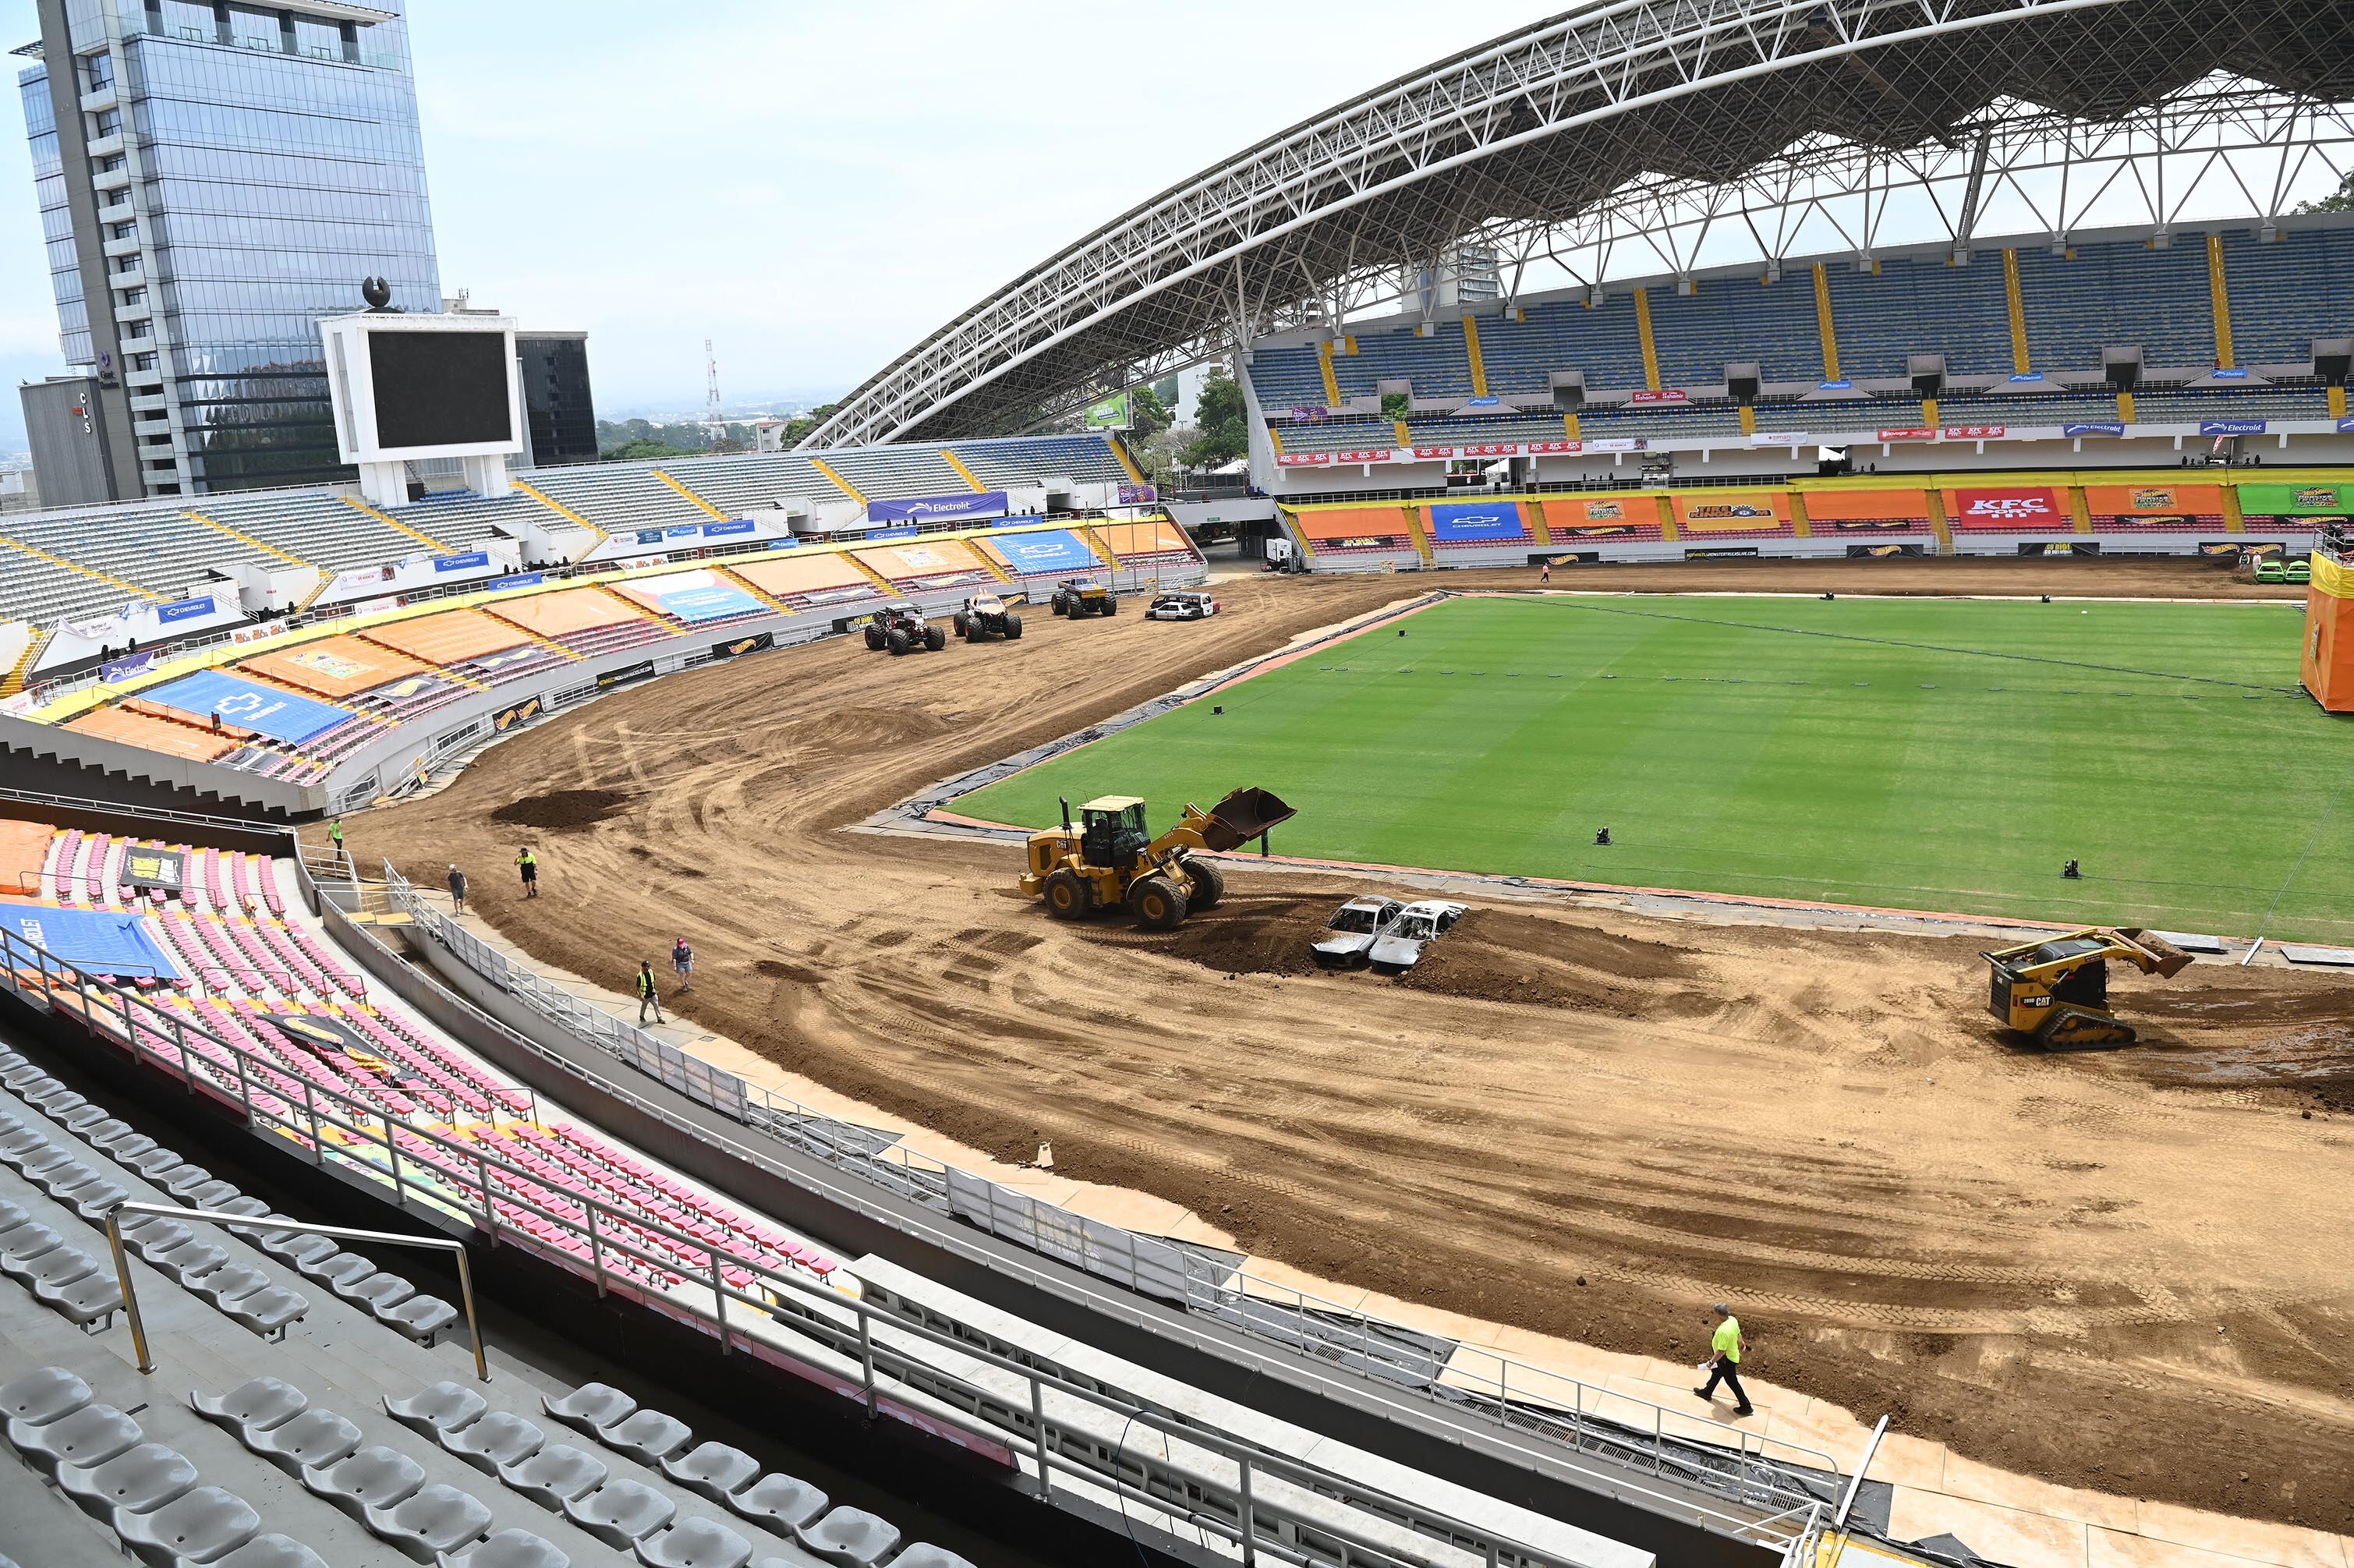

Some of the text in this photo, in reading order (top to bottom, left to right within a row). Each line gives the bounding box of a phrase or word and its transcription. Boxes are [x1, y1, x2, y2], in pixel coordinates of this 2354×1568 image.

[2090, 423, 2122, 433] Electrolit
[2228, 423, 2262, 432] Electrolit
[933, 501, 971, 512] Electrolit
[1971, 498, 2044, 510] KFC
[508, 578, 533, 586] CHEVROLET
[179, 603, 206, 614] CHEVROLET
[2036, 996, 2051, 1007] CAT
